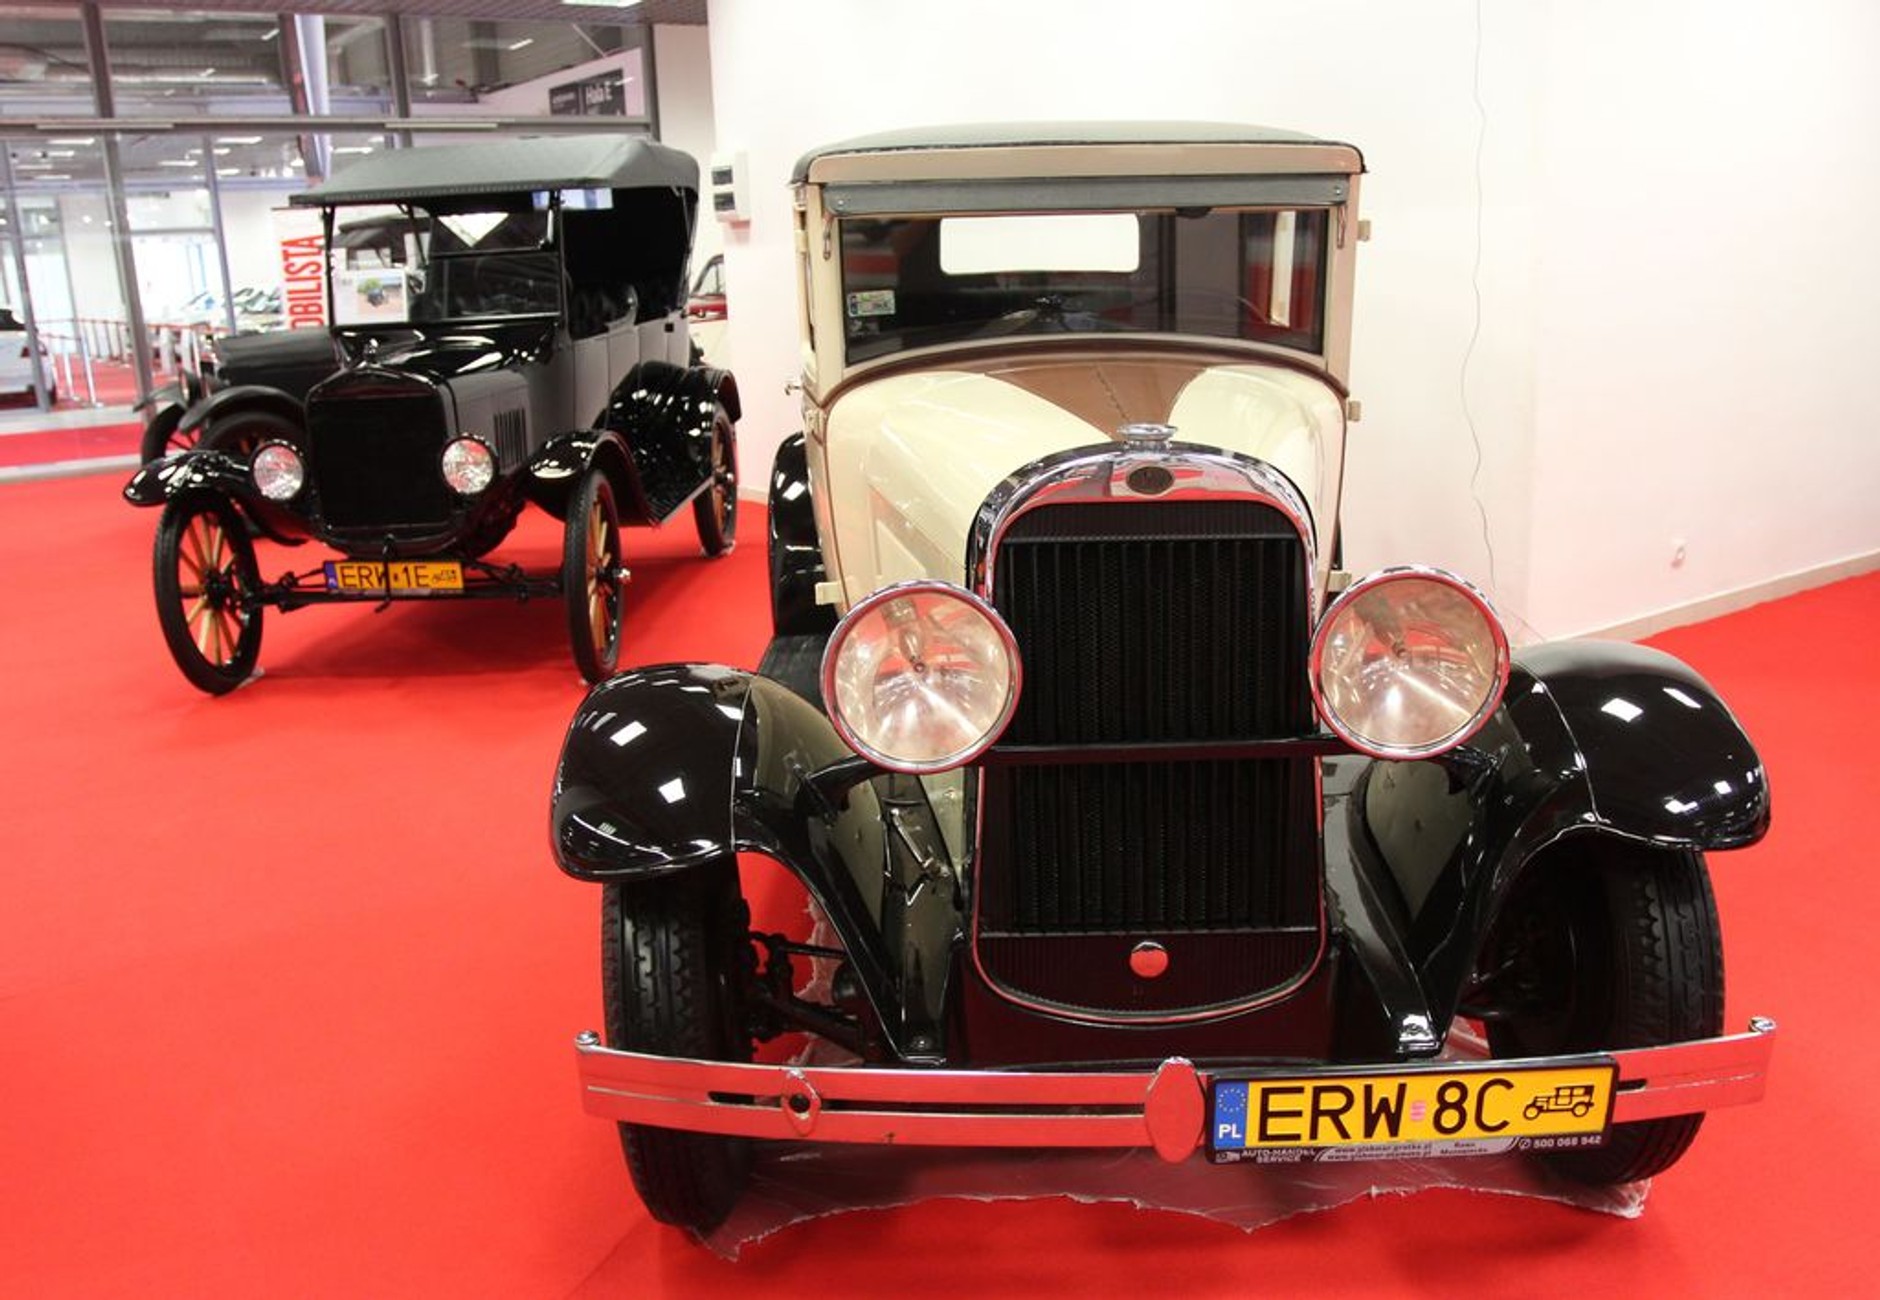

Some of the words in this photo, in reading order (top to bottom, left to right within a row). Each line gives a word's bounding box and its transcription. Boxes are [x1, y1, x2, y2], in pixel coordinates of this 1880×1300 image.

[402, 565, 430, 588] 1E
[1258, 1083, 1407, 1142] ERW
[1433, 1078, 1514, 1135] 8C
[1218, 1123, 1242, 1140] PL
